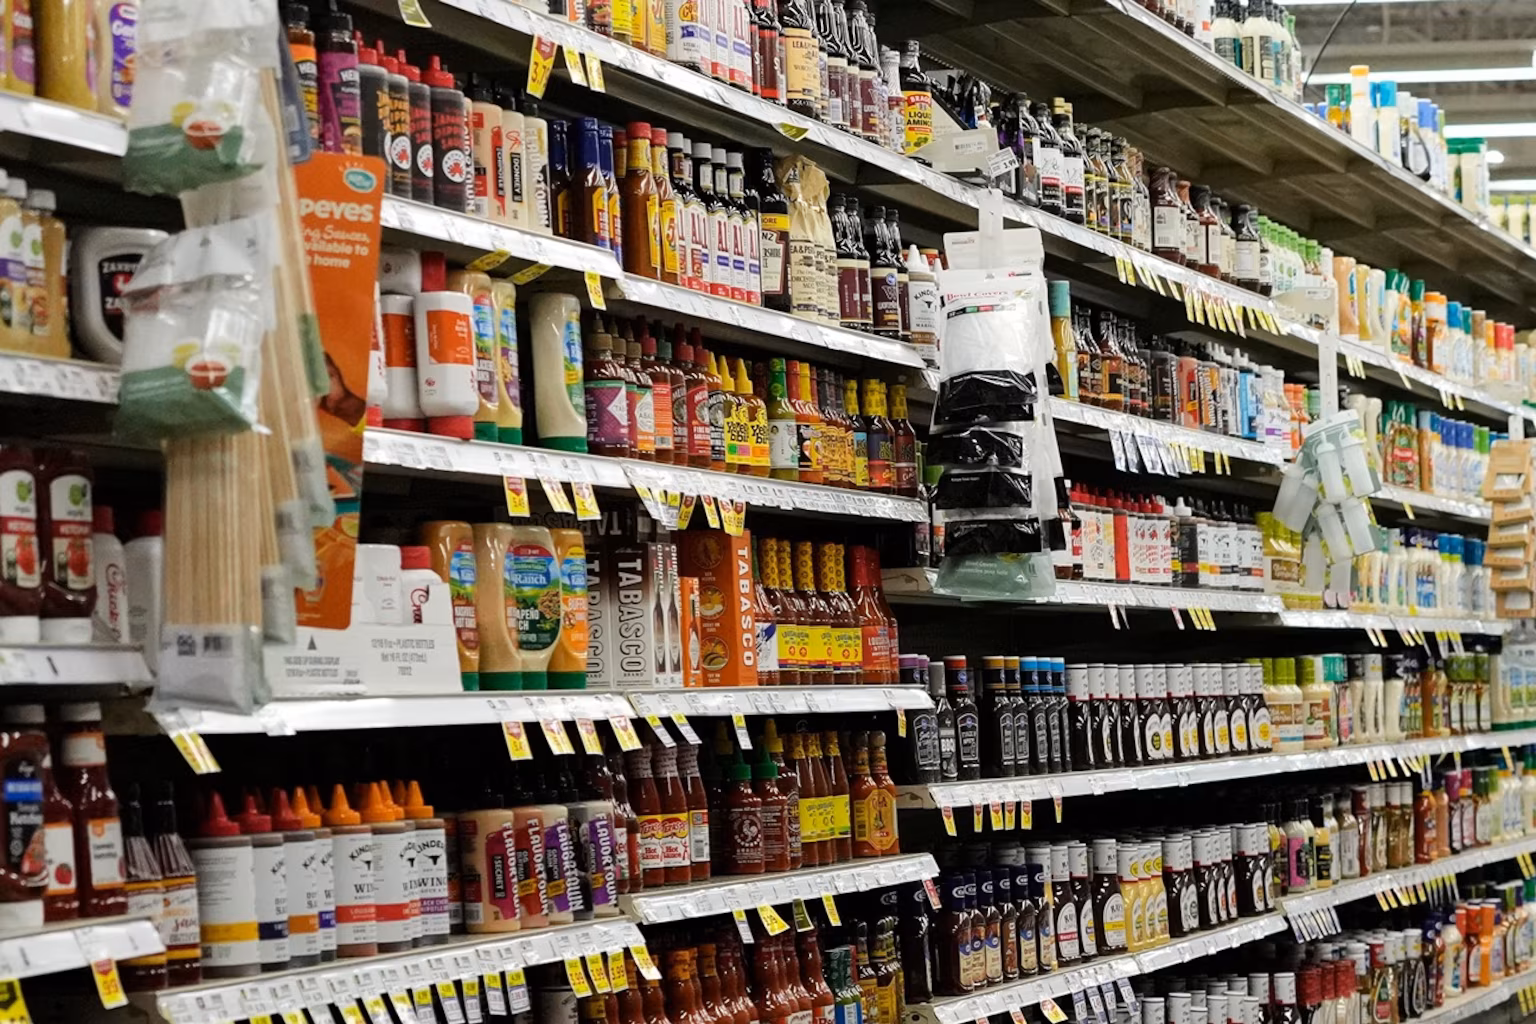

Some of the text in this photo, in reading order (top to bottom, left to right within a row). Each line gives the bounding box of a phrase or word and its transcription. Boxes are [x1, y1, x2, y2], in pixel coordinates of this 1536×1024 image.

[1003, 158, 1018, 170] 3.99
[354, 245, 369, 256] to
[314, 254, 351, 268] home
[514, 571, 547, 586] Ranch
[737, 546, 754, 667] TABASCO
[617, 558, 647, 674] TABASCO
